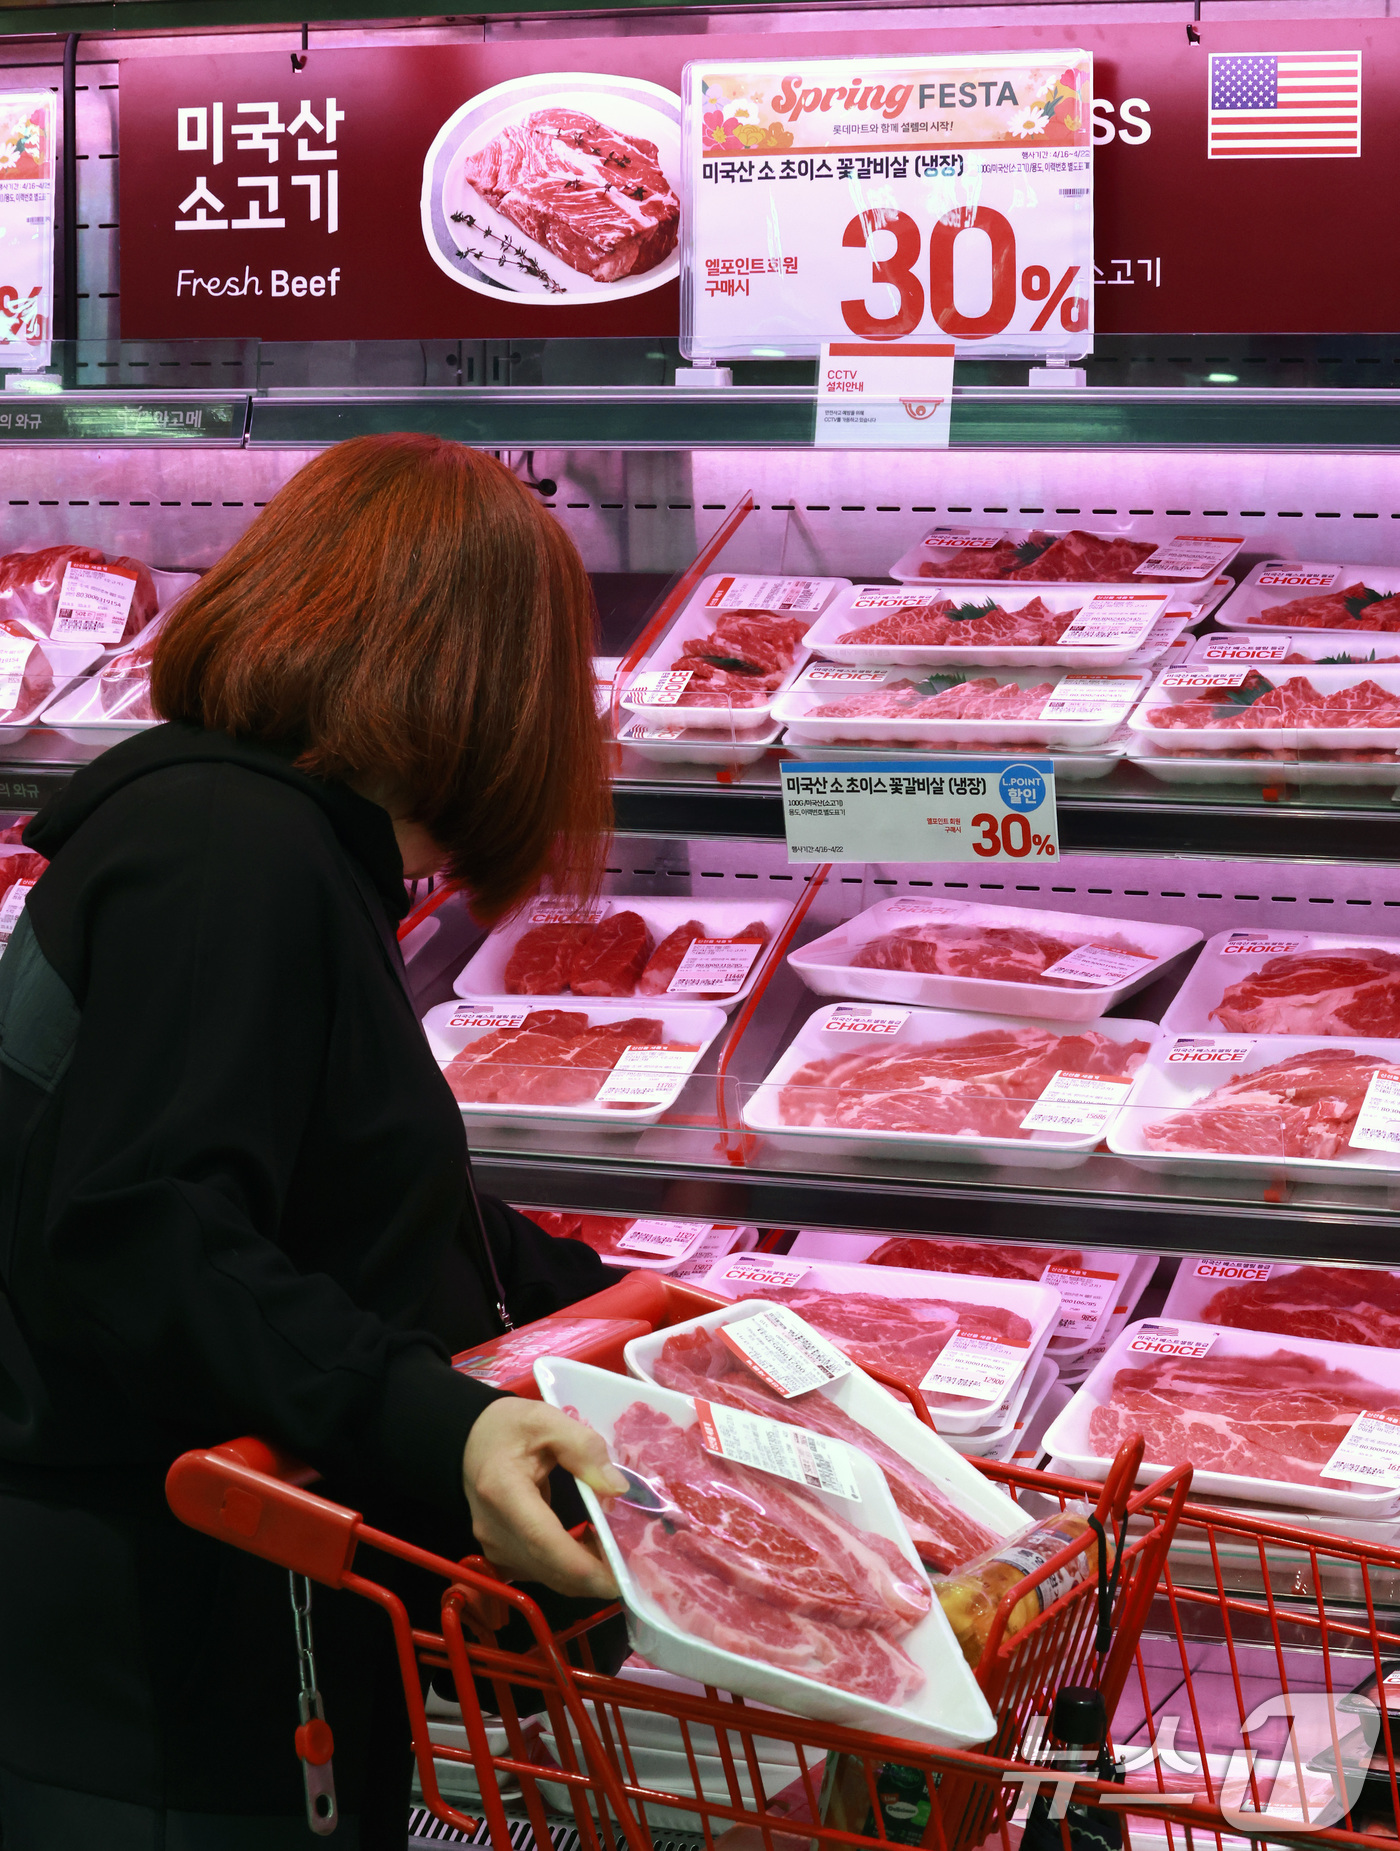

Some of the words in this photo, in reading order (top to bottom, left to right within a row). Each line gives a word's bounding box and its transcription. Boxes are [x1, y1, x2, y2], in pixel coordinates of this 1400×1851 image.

[771, 75, 914, 122] Spring
[918, 81, 1019, 109] FESTA
[177, 97, 345, 165] 미국산
[833, 123, 879, 135] 롯데마트와
[881, 122, 899, 134] 함께
[901, 121, 928, 133] 설렘의
[930, 120, 954, 132] 시작!
[702, 160, 755, 184] 미국산
[757, 160, 776, 180] 소
[778, 159, 833, 181] 초이스
[836, 155, 909, 181] 꽃갈비살
[914, 153, 964, 178] (냉장)
[175, 169, 338, 234] 소고기
[705, 257, 766, 277] 엘포인트
[840, 205, 1089, 342] 30%
[177, 265, 263, 297] Fresh
[271, 267, 341, 297] Beef
[704, 279, 750, 297] 구매시
[827, 369, 858, 380] CCTV
[826, 381, 864, 392] 설치안내
[15, 413, 42, 430] 와규
[924, 538, 995, 547] CHOICE
[1259, 576, 1333, 585] CHOICE
[855, 598, 929, 608] CHOICE
[1206, 650, 1284, 658] CHOICE
[809, 671, 886, 680] CHOICE
[1162, 677, 1241, 686] CHOICE
[657, 670, 690, 703] CHOICE
[786, 776, 828, 795] 미국산
[830, 777, 844, 793] 소
[846, 776, 888, 795] 초이스
[888, 776, 944, 795] 꽃갈비살
[948, 776, 987, 796] (냉장)
[1002, 777, 1041, 787] L.POINT
[13, 783, 39, 798] 와규
[1008, 788, 1037, 804] 할인
[926, 818, 949, 826] 엘포인트
[971, 812, 1056, 858] 30%
[1224, 945, 1298, 953] CHOICE
[449, 1018, 522, 1027] CHOICE
[825, 1021, 899, 1033] CHOICE
[1168, 1052, 1245, 1062] CHOICE
[725, 1270, 797, 1285] CHOICE
[1197, 1265, 1269, 1280] CHOICE
[1130, 1340, 1207, 1357] CHOICE
[984, 1376, 1005, 1386] 12900
